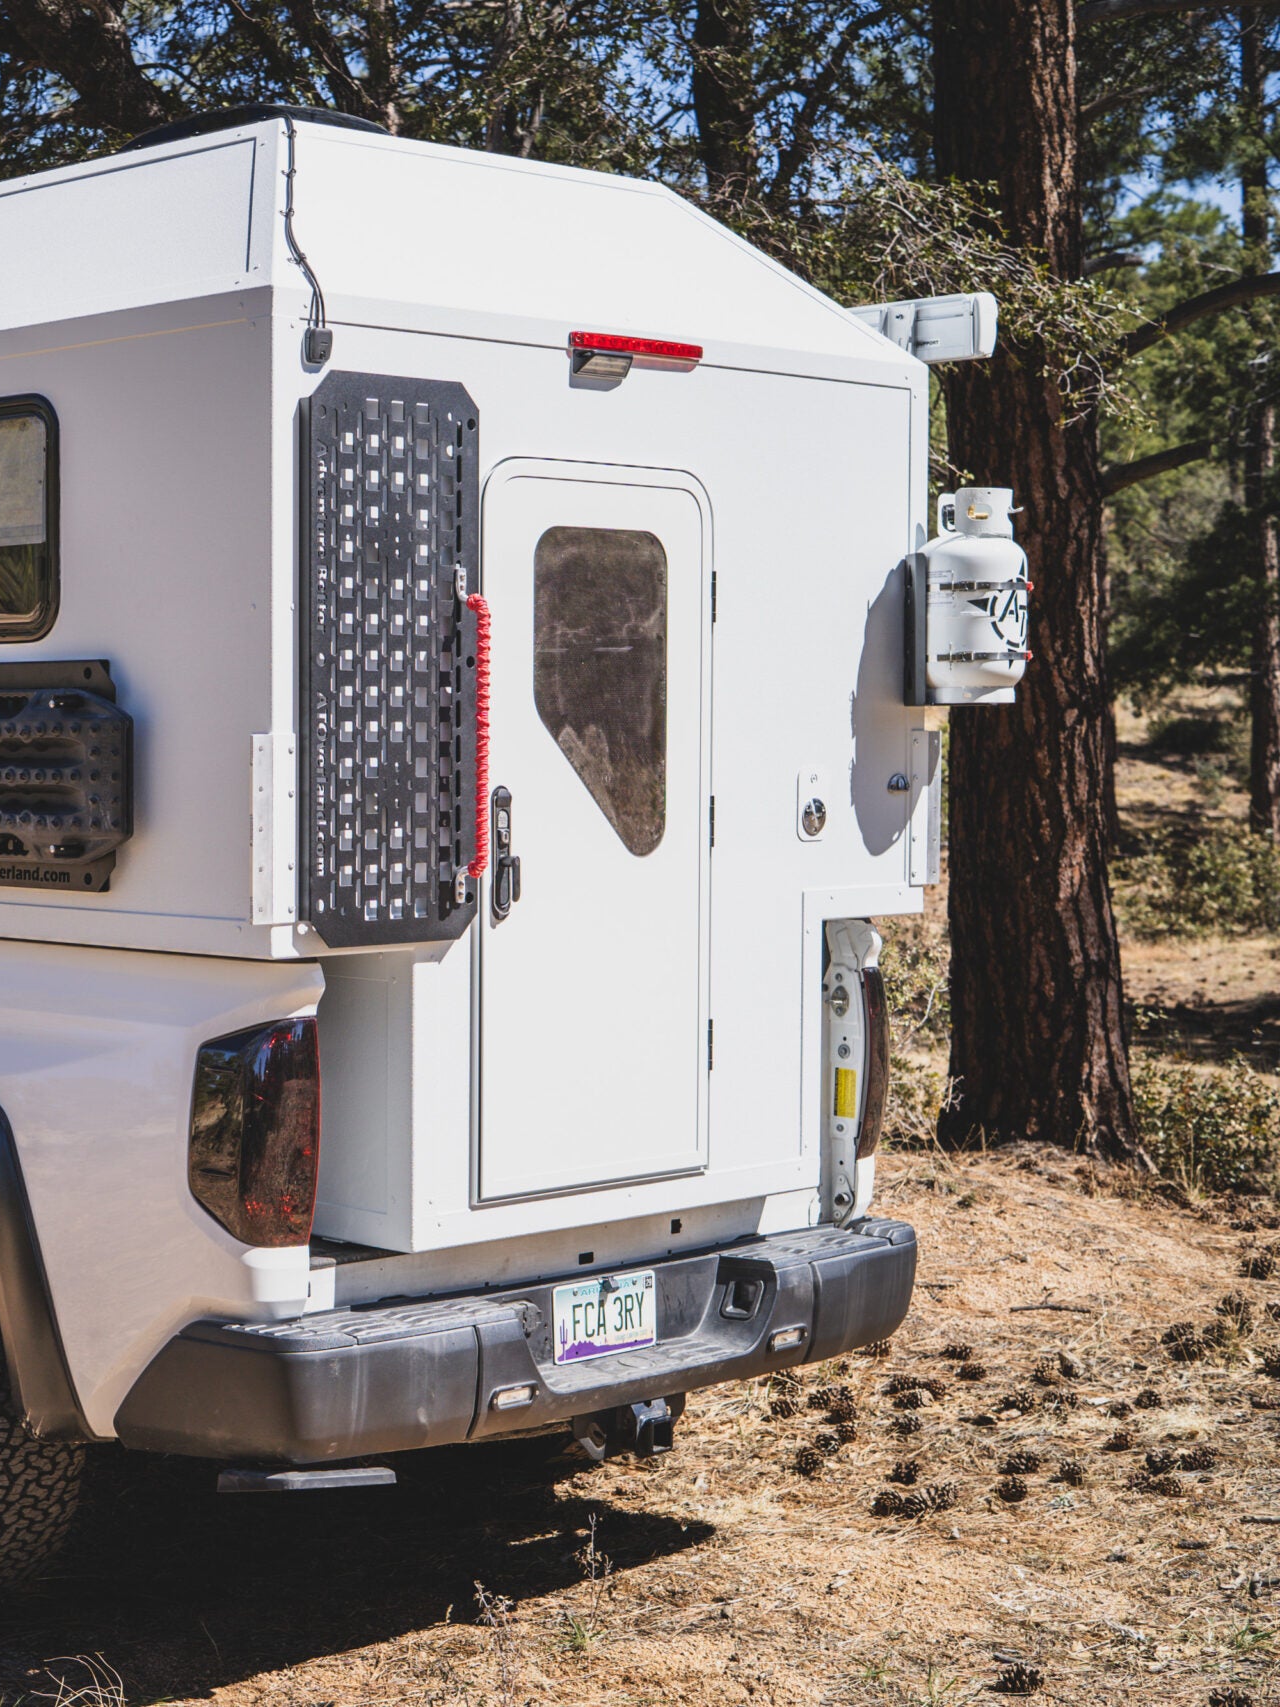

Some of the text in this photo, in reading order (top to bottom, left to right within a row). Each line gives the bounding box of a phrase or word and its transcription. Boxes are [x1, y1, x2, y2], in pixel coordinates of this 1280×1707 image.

[317, 438, 328, 634] Adventure Better
[317, 692, 328, 877] ATOverland.com
[572, 1291, 644, 1341] FCA 3RY
